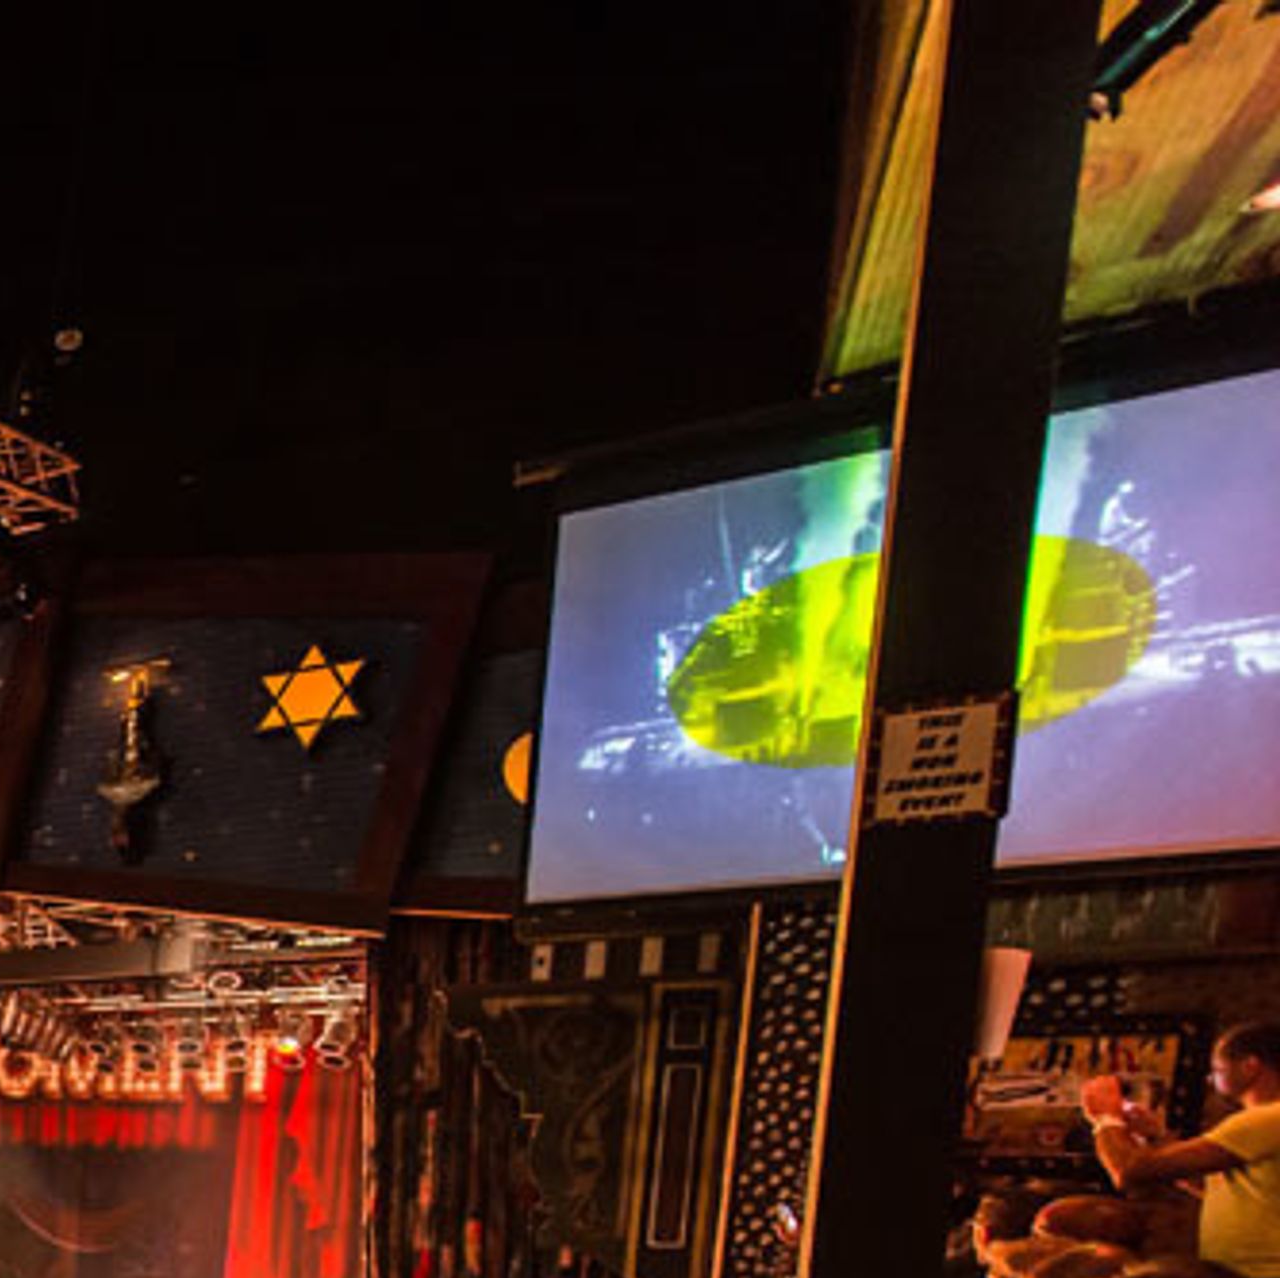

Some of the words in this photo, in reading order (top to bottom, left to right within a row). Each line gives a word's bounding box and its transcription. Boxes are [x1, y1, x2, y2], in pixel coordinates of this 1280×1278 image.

[918, 714, 963, 730] THIS
[917, 736, 936, 750] IS
[943, 735, 959, 746] A
[911, 755, 957, 770] NON
[885, 772, 983, 793] SMOKING
[898, 794, 964, 811] EVENT
